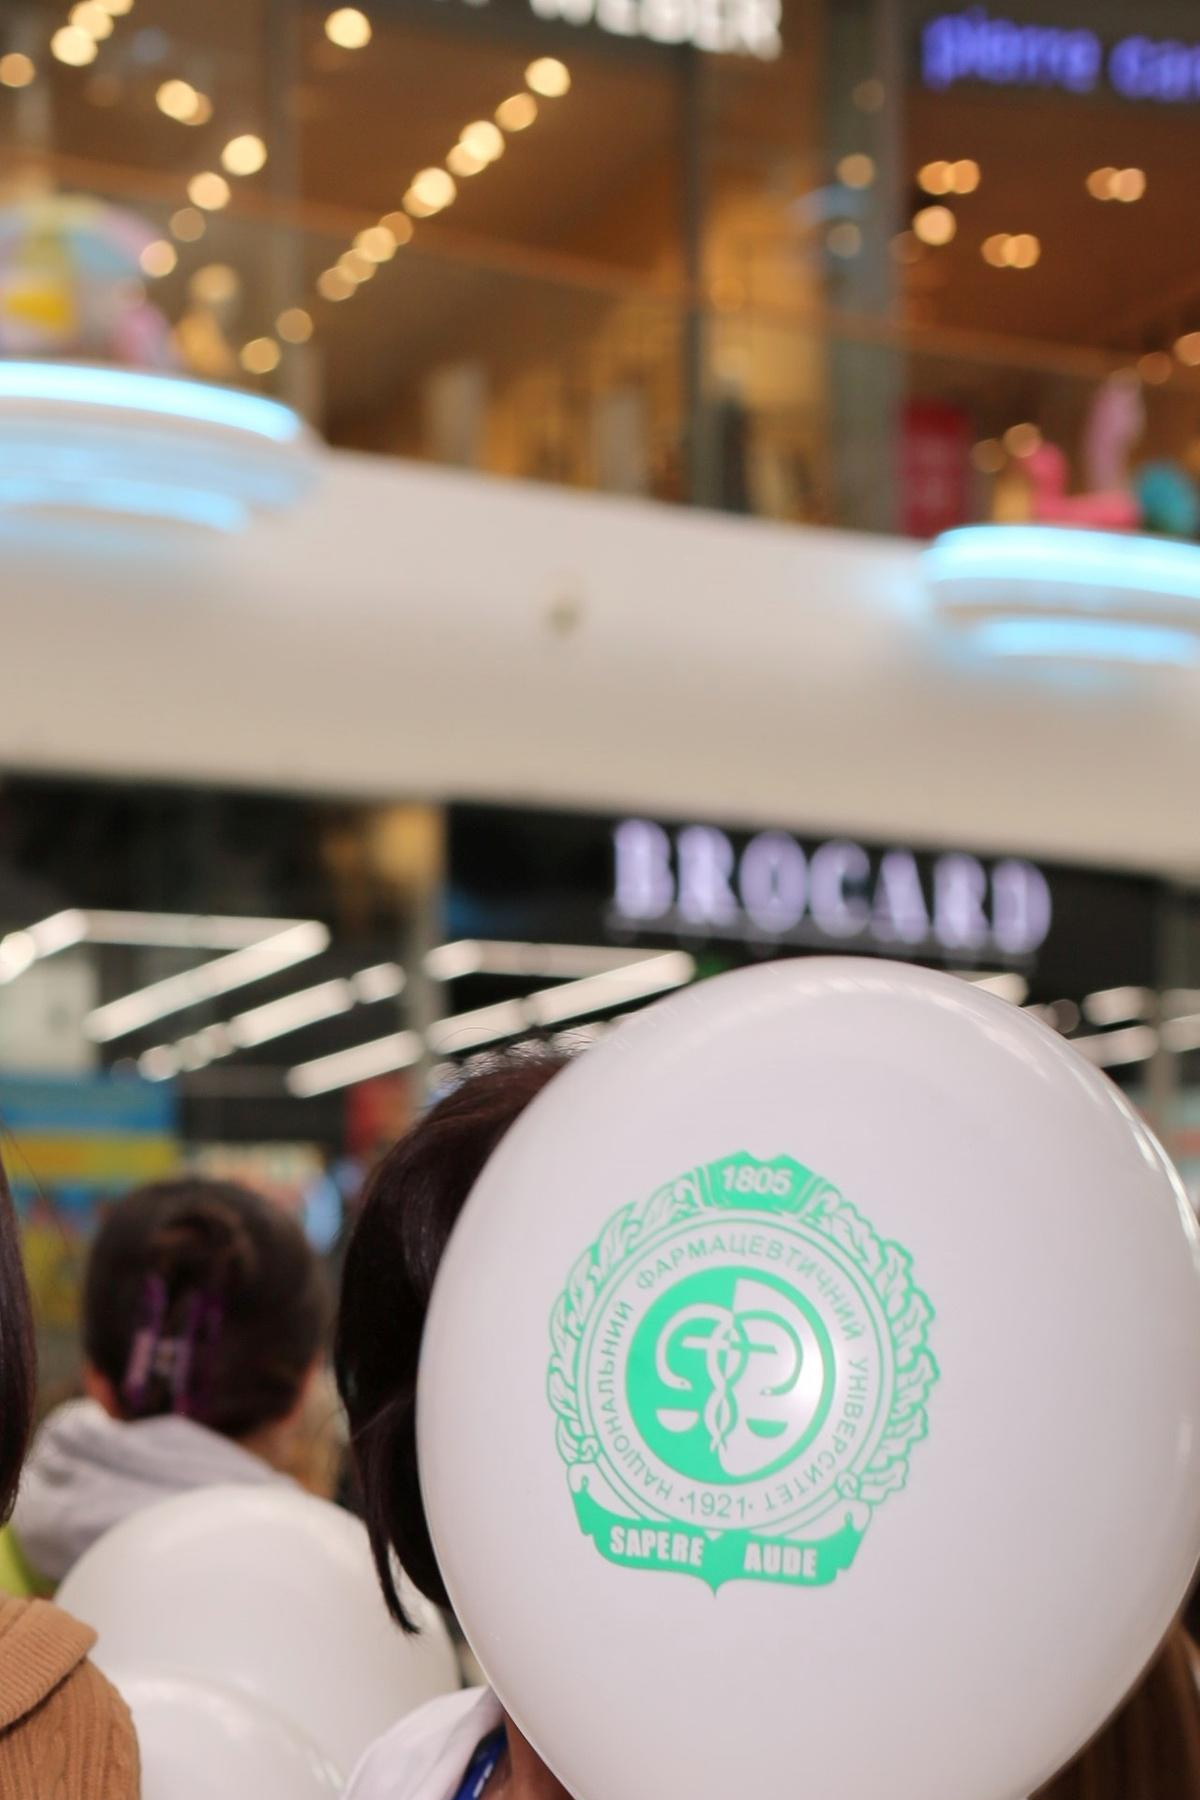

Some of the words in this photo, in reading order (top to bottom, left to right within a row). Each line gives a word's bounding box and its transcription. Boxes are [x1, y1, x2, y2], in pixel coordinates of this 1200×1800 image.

[614, 818, 1051, 954] BROCARD
[722, 1164, 792, 1196] 1805
[635, 1233, 866, 1341] ФАРМАЦЕВТИЧНИЙ
[597, 1300, 674, 1501] НАЦІОНАЛЬНИЙ
[764, 1357, 869, 1511] УНІВЕРСИТЕТ
[609, 1525, 704, 1567] SAPERE
[743, 1542, 818, 1578] AUDE
